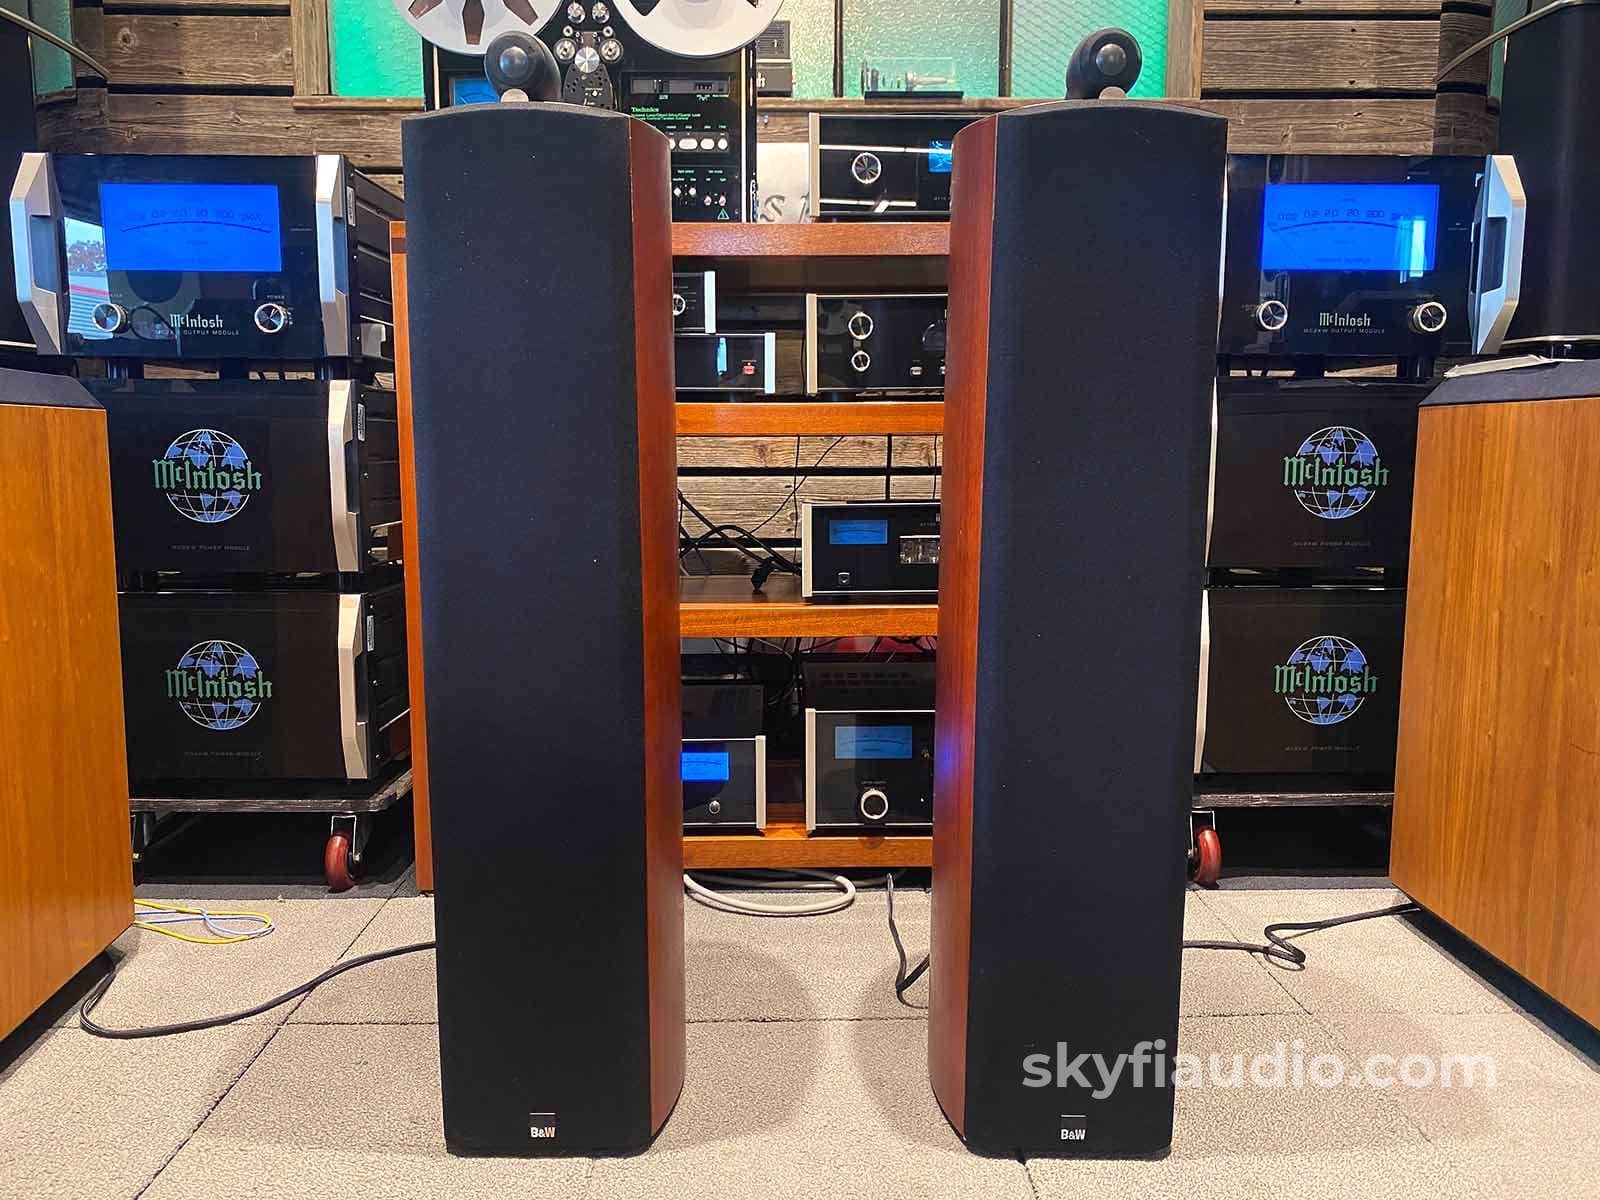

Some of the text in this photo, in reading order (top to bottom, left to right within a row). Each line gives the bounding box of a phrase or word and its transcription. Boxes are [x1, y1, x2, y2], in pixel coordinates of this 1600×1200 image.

[170, 313, 223, 329] McIntosh
[1319, 312, 1371, 327] McIntosh
[152, 458, 263, 491] McIntosh
[1283, 456, 1390, 487] McIntosh
[164, 669, 273, 699] McIntosh
[1273, 664, 1378, 694] McIntosh
[530, 1126, 556, 1138] B&W
[1060, 1128, 1086, 1140] B&W
